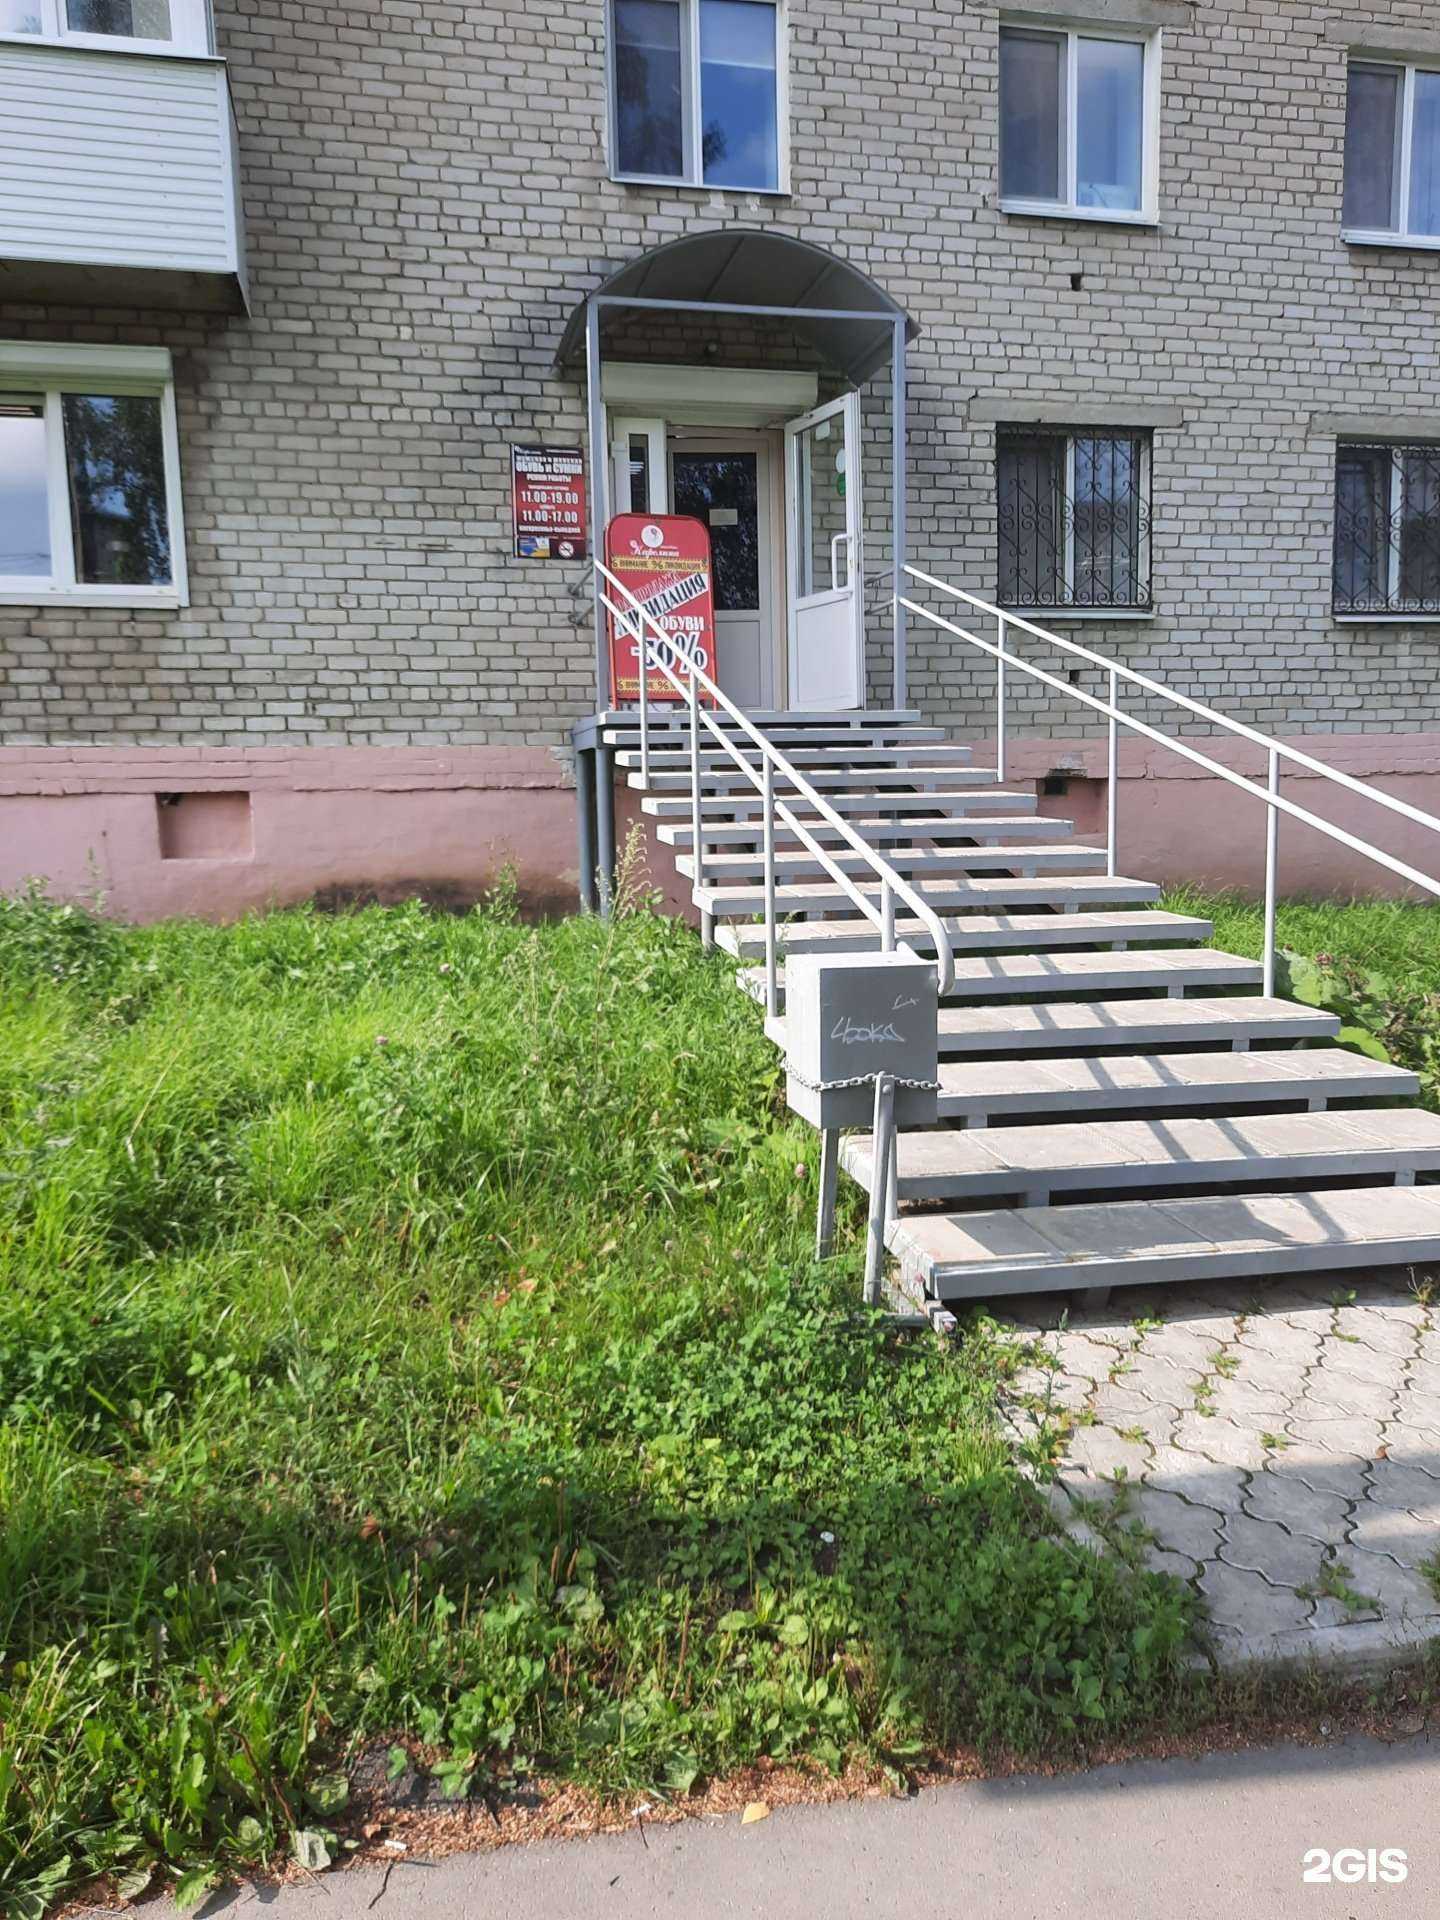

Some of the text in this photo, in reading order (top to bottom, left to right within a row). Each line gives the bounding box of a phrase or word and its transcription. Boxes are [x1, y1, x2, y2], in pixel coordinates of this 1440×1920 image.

[516, 462, 544, 472] ОБУВЬ
[553, 464, 582, 474] СУМКИ
[521, 491, 579, 504] 11.00-19.00
[522, 510, 578, 523] 11.00-17.00
[659, 616, 704, 631] ОБУВИ
